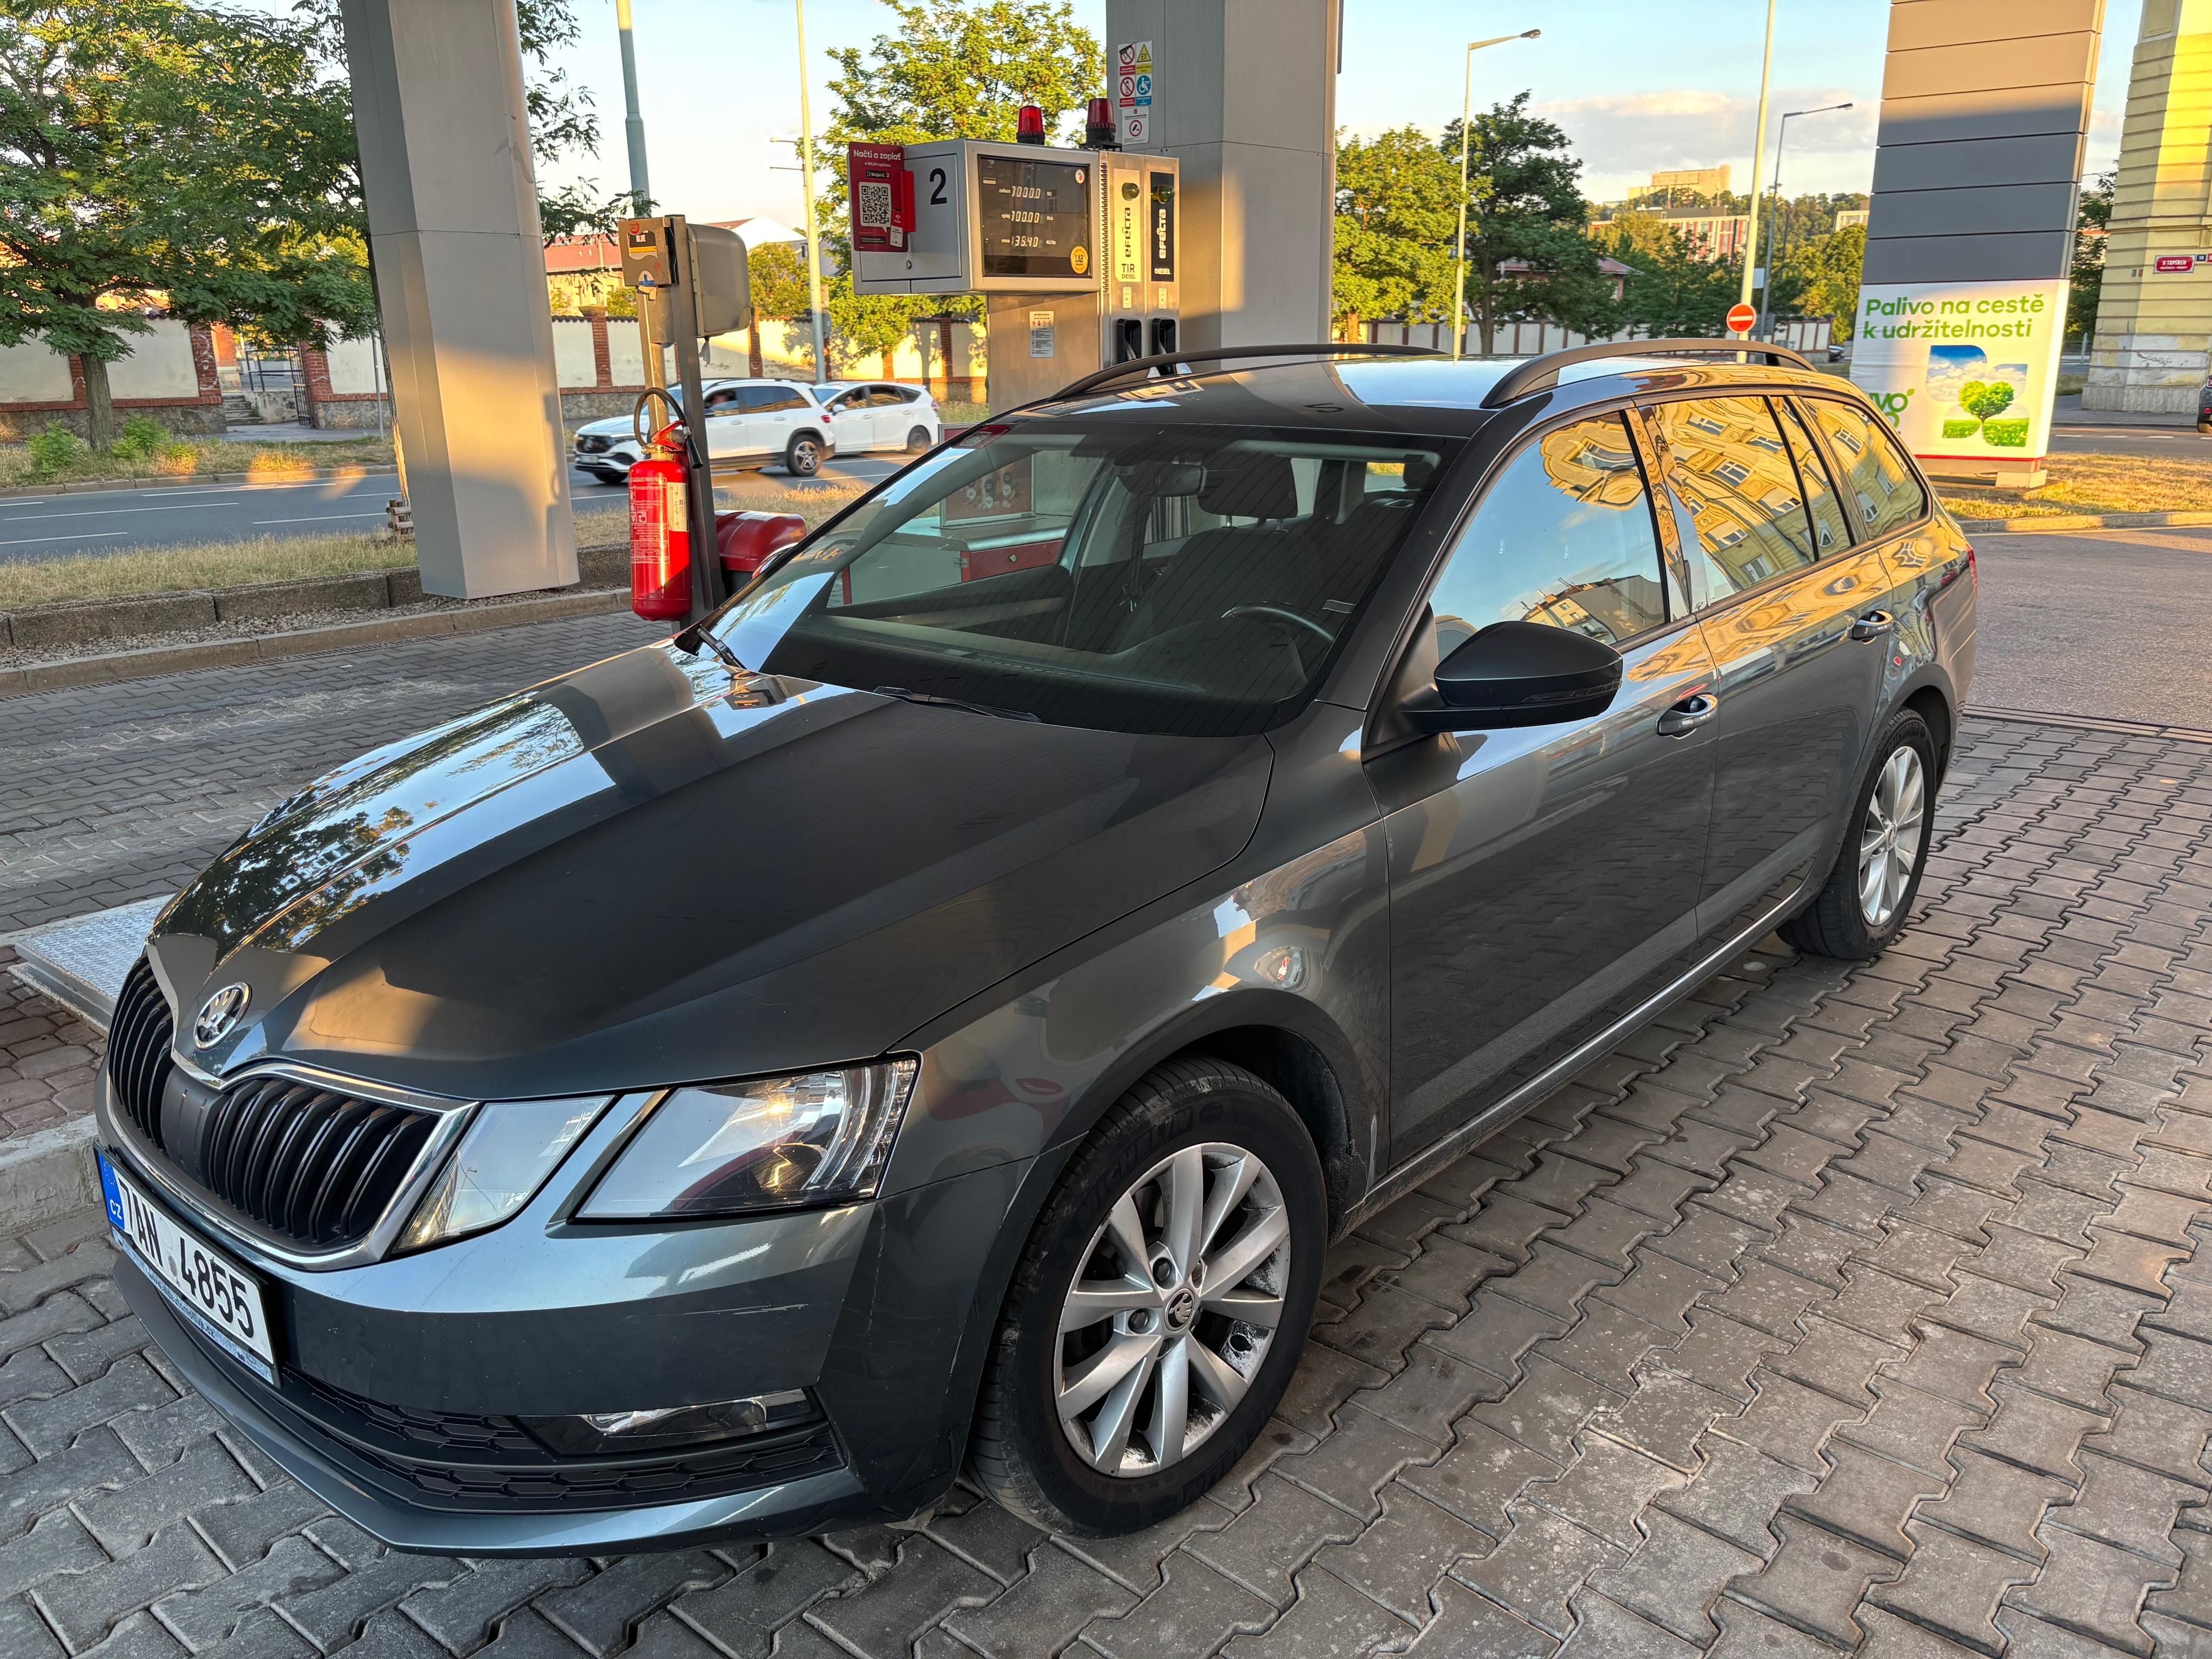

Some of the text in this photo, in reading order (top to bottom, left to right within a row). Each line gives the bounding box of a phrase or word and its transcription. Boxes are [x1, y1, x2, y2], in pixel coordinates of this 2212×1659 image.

[853, 150, 873, 158] Načti
[879, 152, 901, 161] zaplať
[929, 167, 947, 205] 2
[1121, 264, 1135, 273] TIR
[1865, 294, 2044, 316] Palivo na cestě
[1863, 318, 2033, 339] k udržitelnosti
[110, 1199, 123, 1220] CZ
[179, 1236, 254, 1339] 4855
